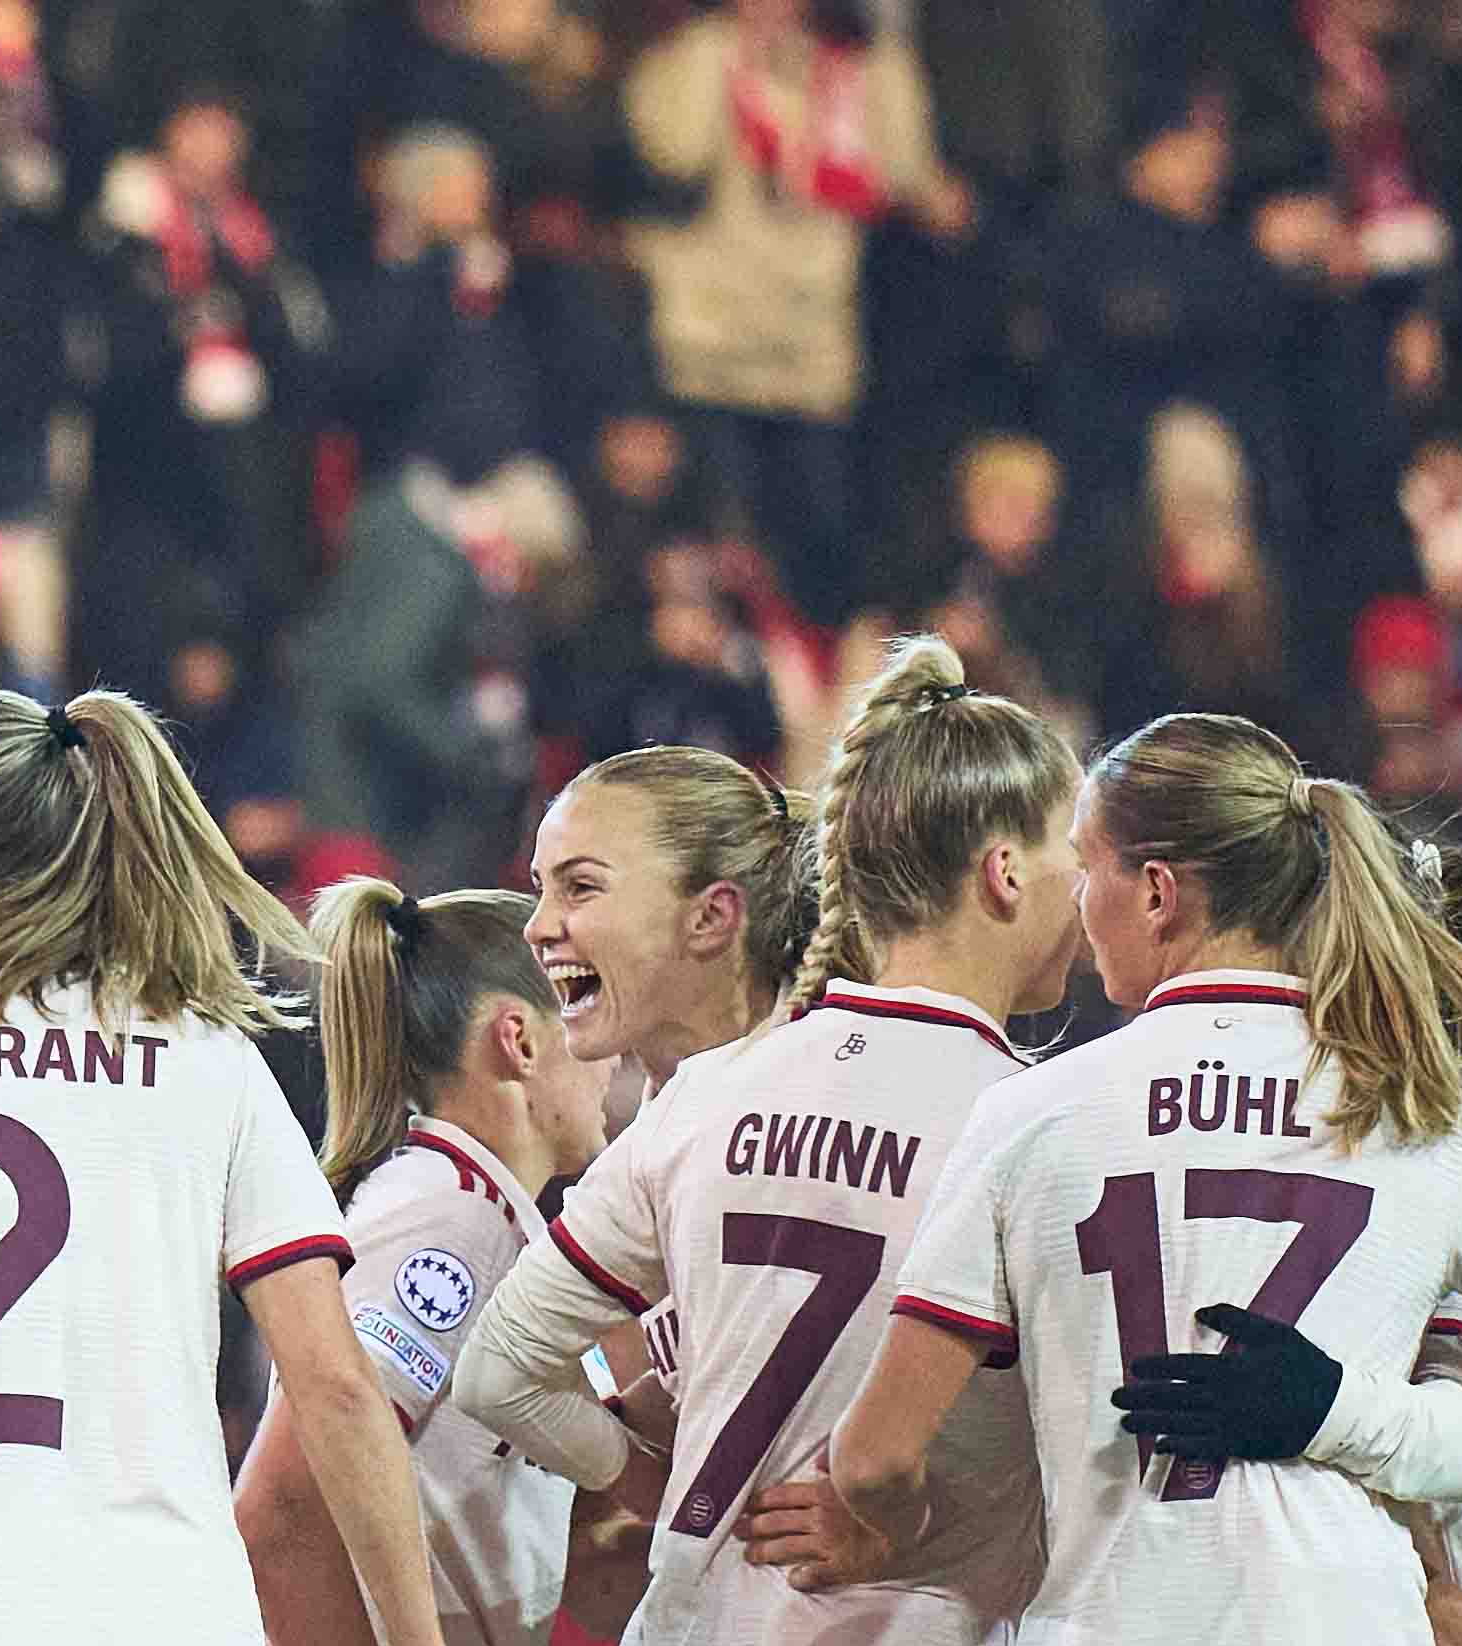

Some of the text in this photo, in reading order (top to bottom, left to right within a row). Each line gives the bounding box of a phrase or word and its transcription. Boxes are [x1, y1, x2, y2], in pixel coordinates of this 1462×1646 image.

[1147, 1059, 1312, 1138] BÜHL
[726, 1112, 922, 1198] GWINN
[354, 1313, 443, 1382] FOUNDATION
[669, 1212, 886, 1538] 7
[1075, 1168, 1374, 1501] 17
